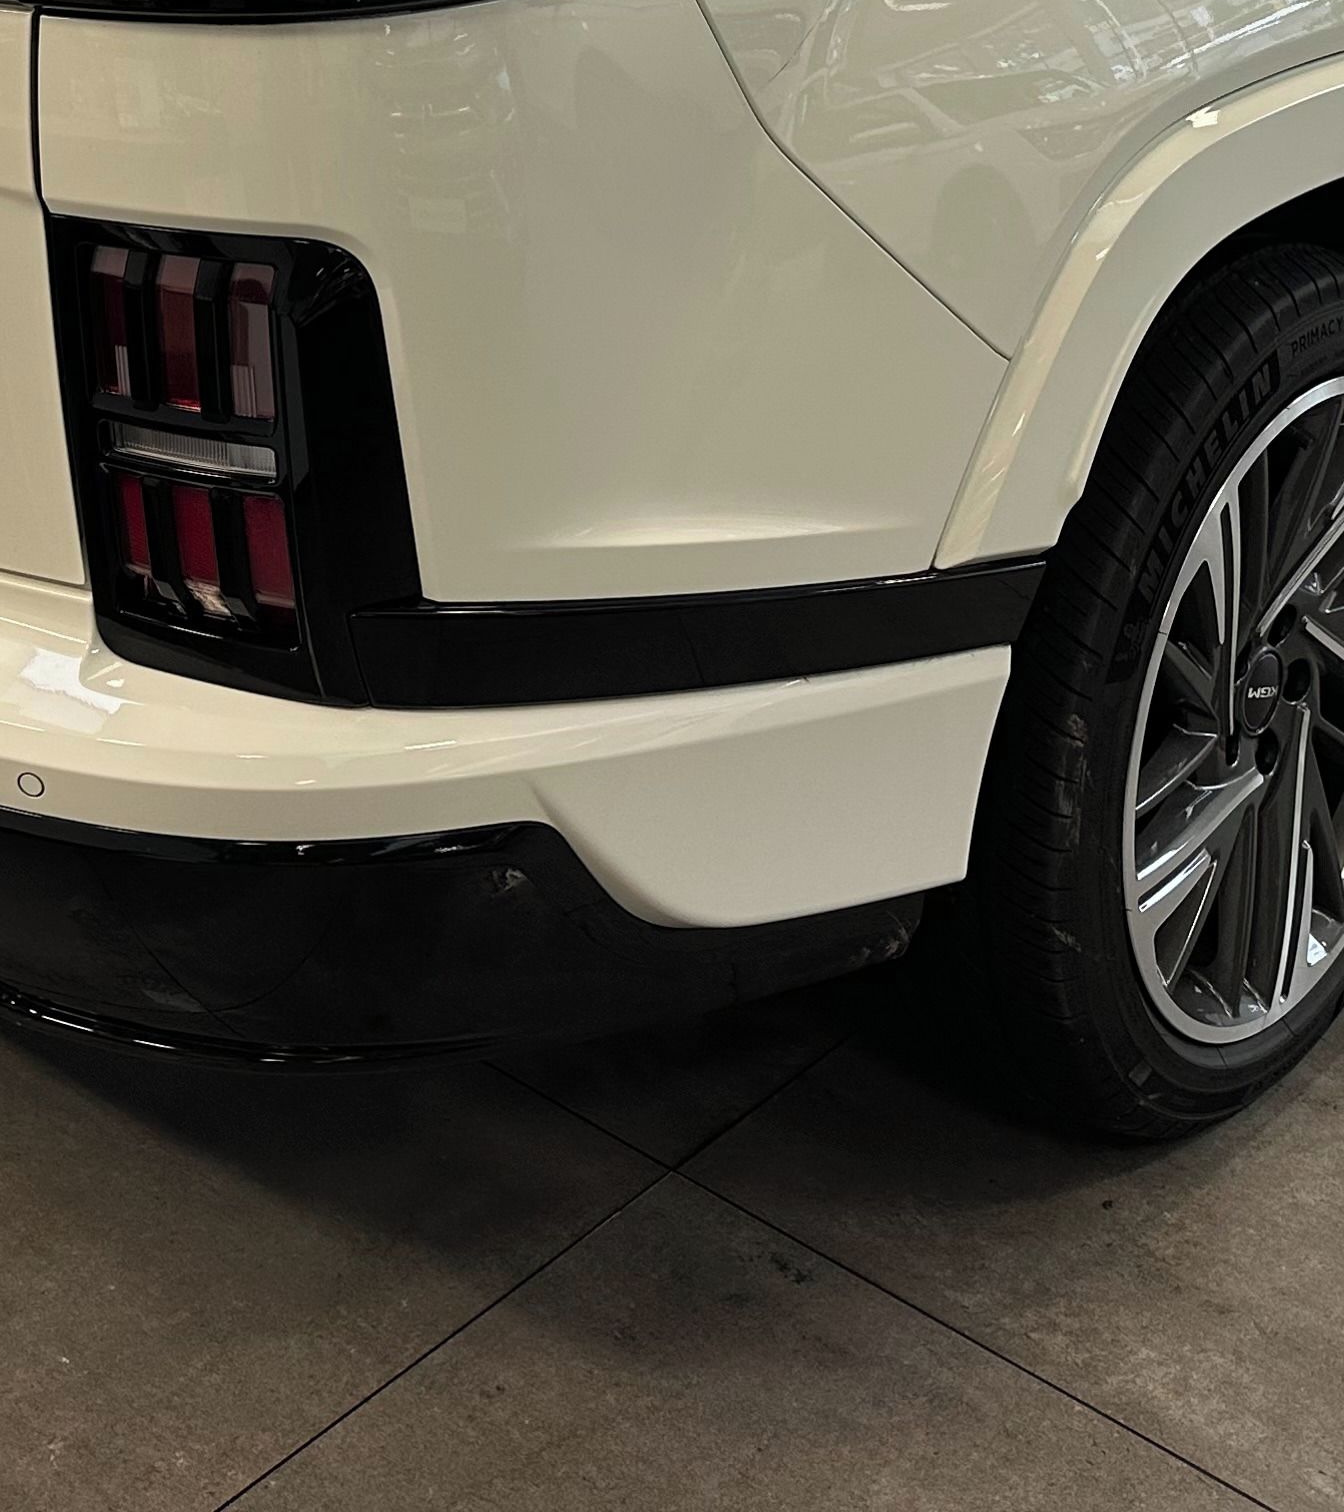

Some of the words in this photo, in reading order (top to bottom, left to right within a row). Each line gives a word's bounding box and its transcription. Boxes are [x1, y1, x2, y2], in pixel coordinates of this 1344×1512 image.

[1290, 315, 1344, 357] PRIMACY
[1137, 358, 1275, 605] MICHELIN
[1247, 685, 1279, 699] KGM
